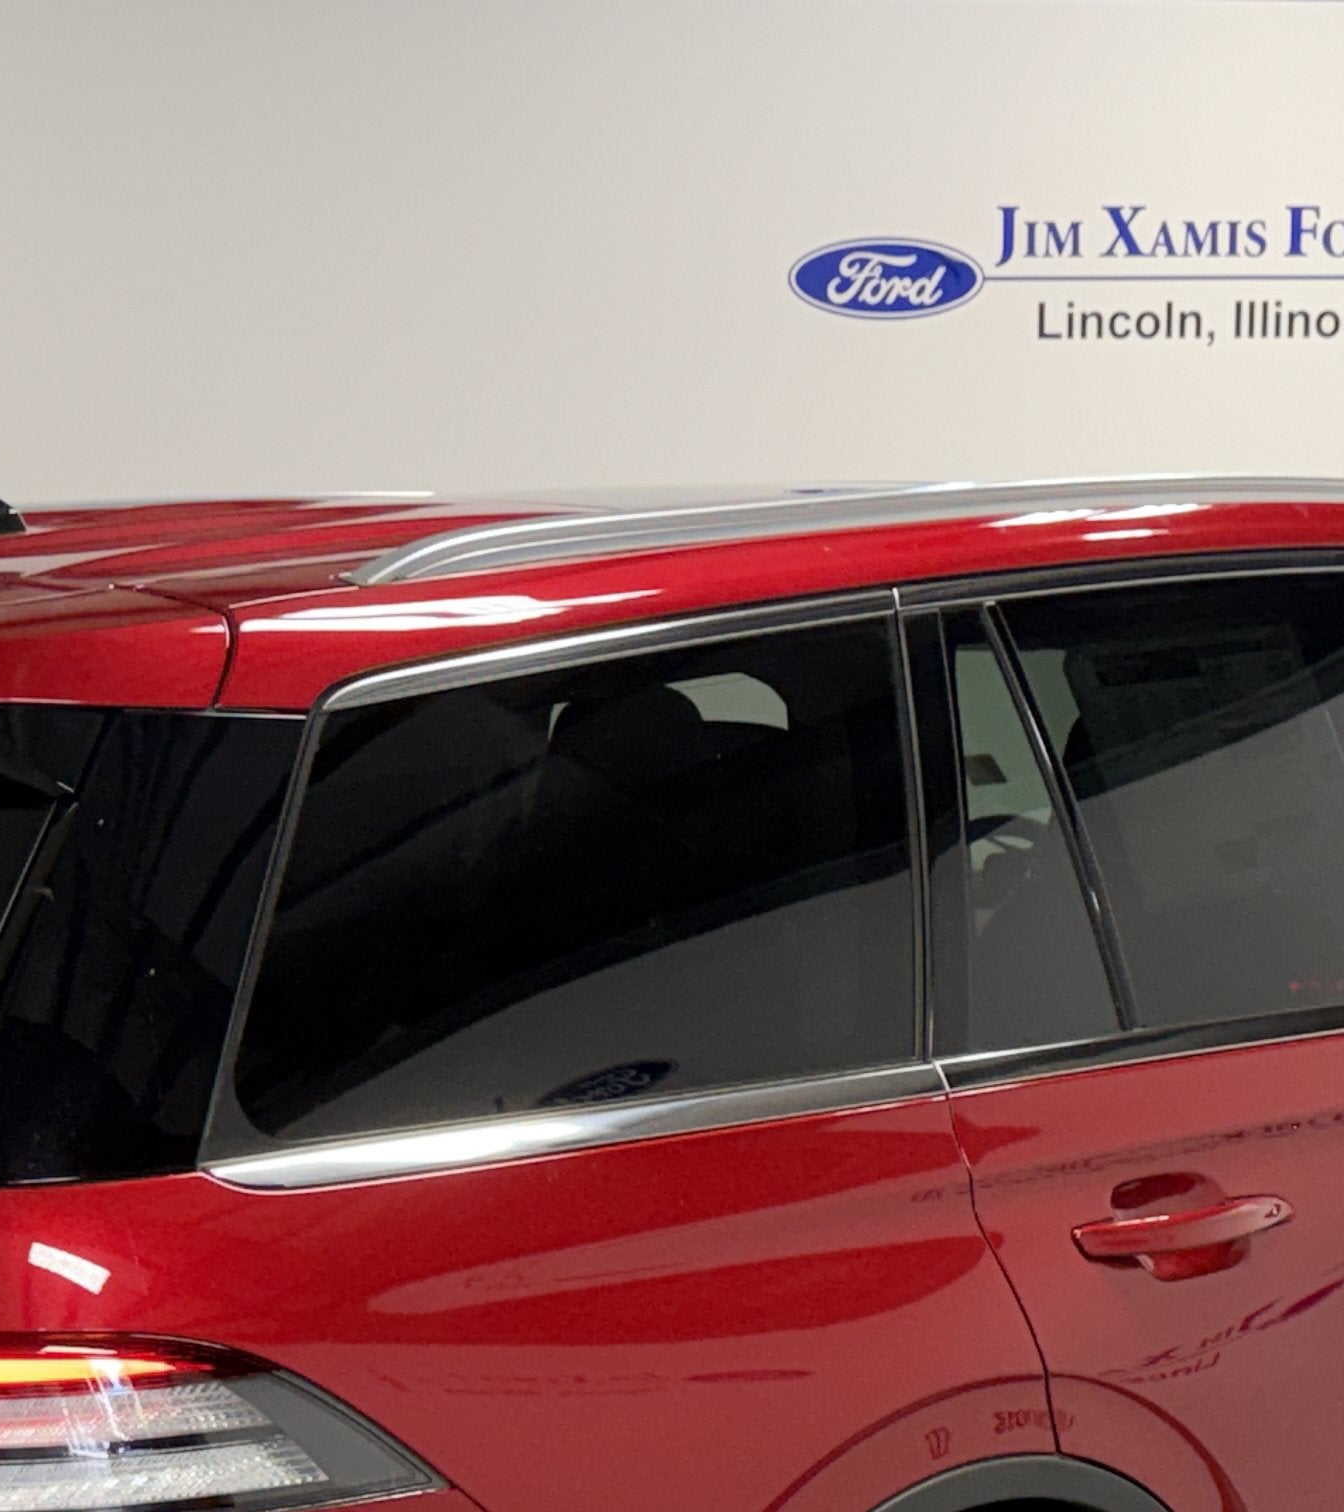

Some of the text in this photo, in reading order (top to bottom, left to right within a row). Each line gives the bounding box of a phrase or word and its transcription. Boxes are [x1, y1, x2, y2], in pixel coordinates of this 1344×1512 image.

[996, 206, 1083, 266] JIM
[1100, 206, 1267, 257] XAMIS
[826, 251, 943, 306] Ford
[1038, 302, 1216, 346] Lincoln,
